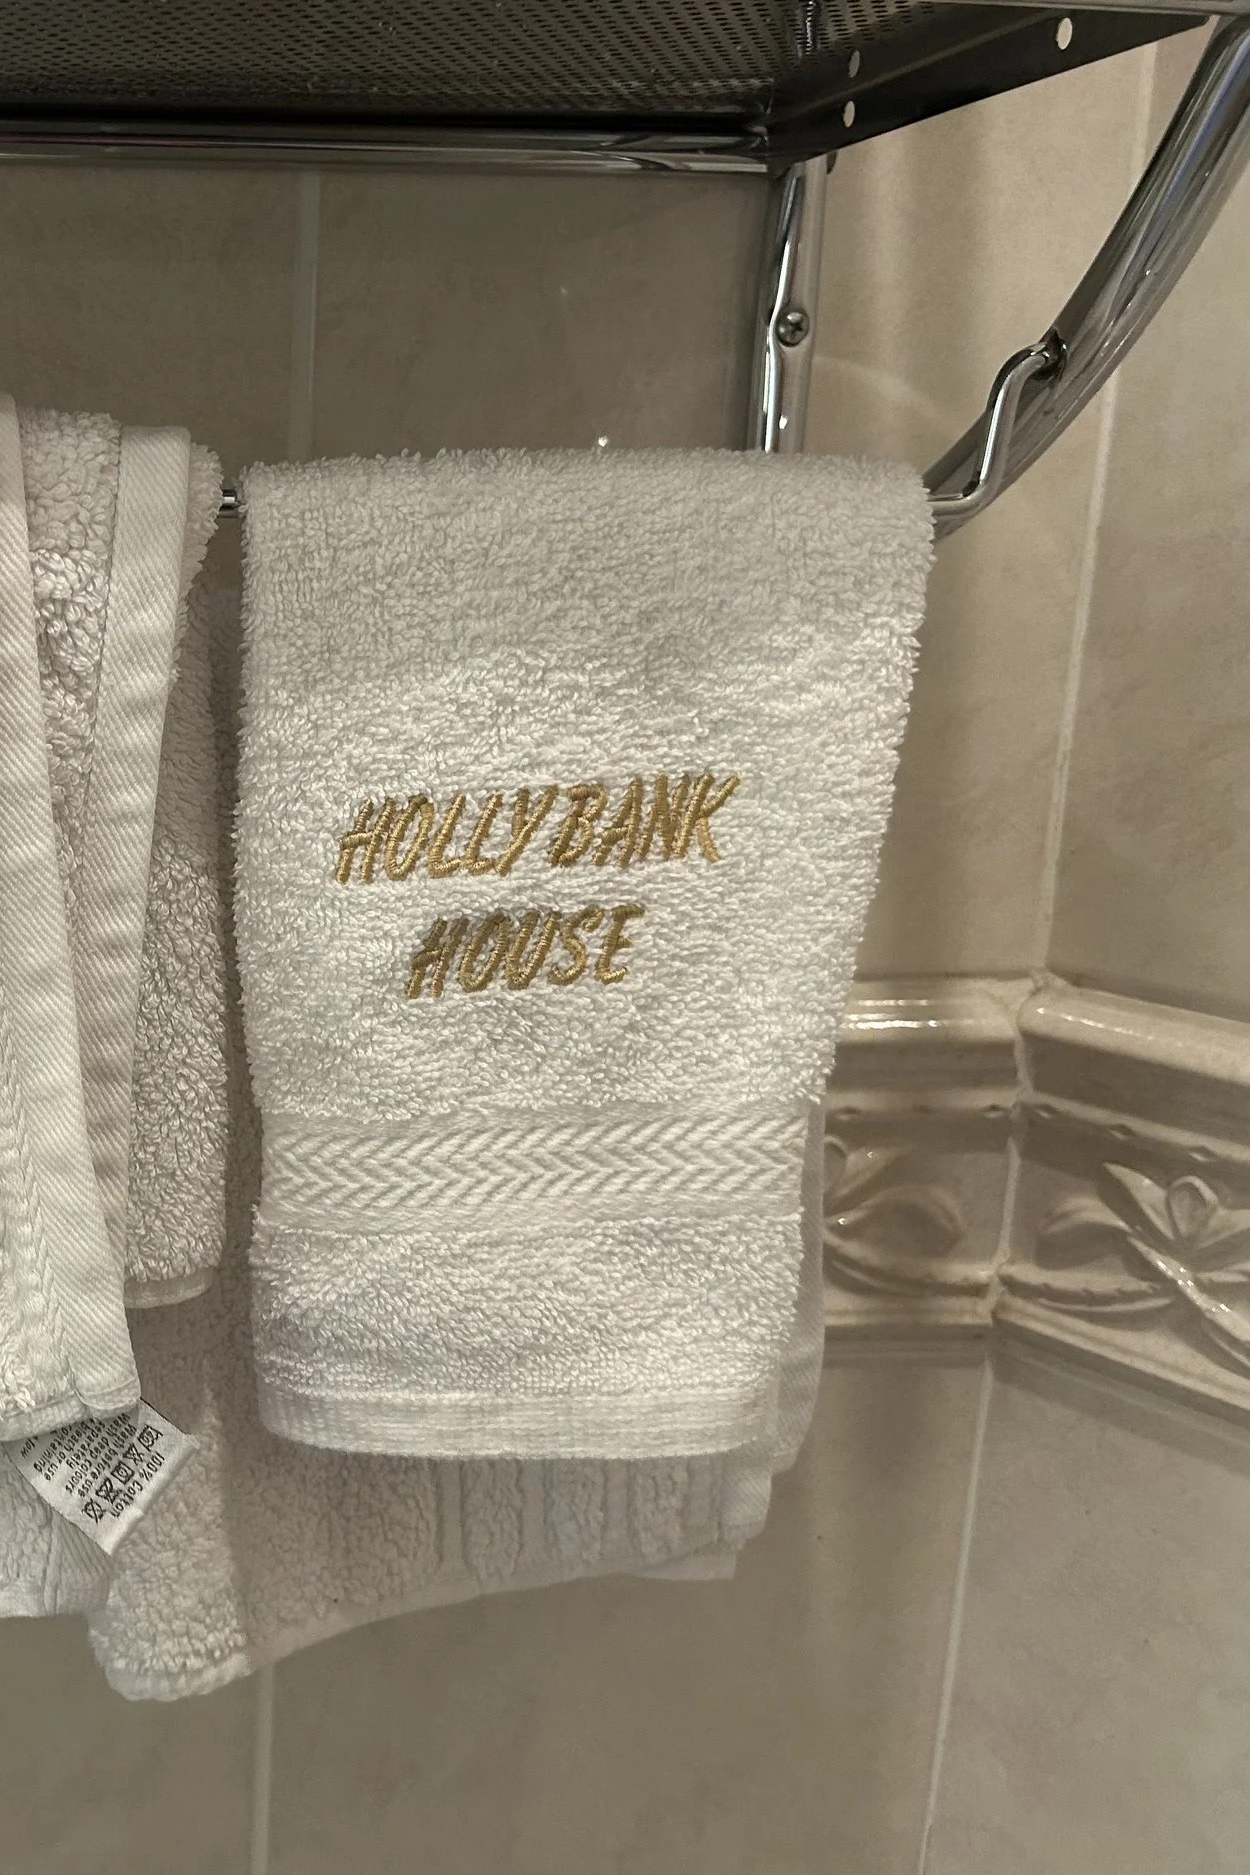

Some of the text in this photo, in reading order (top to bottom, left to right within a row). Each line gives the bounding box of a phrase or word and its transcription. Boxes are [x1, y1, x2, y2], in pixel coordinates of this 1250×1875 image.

[335, 773, 740, 885] HOLLY BANK
[405, 902, 645, 1000] HOUSE
[45, 1424, 90, 1481] bleach or use
[65, 1413, 131, 1494] Wash deep colours
[67, 1421, 106, 1469] separately
[77, 1424, 138, 1498] Wash before use
[110, 1452, 166, 1518] 100% Cotton
